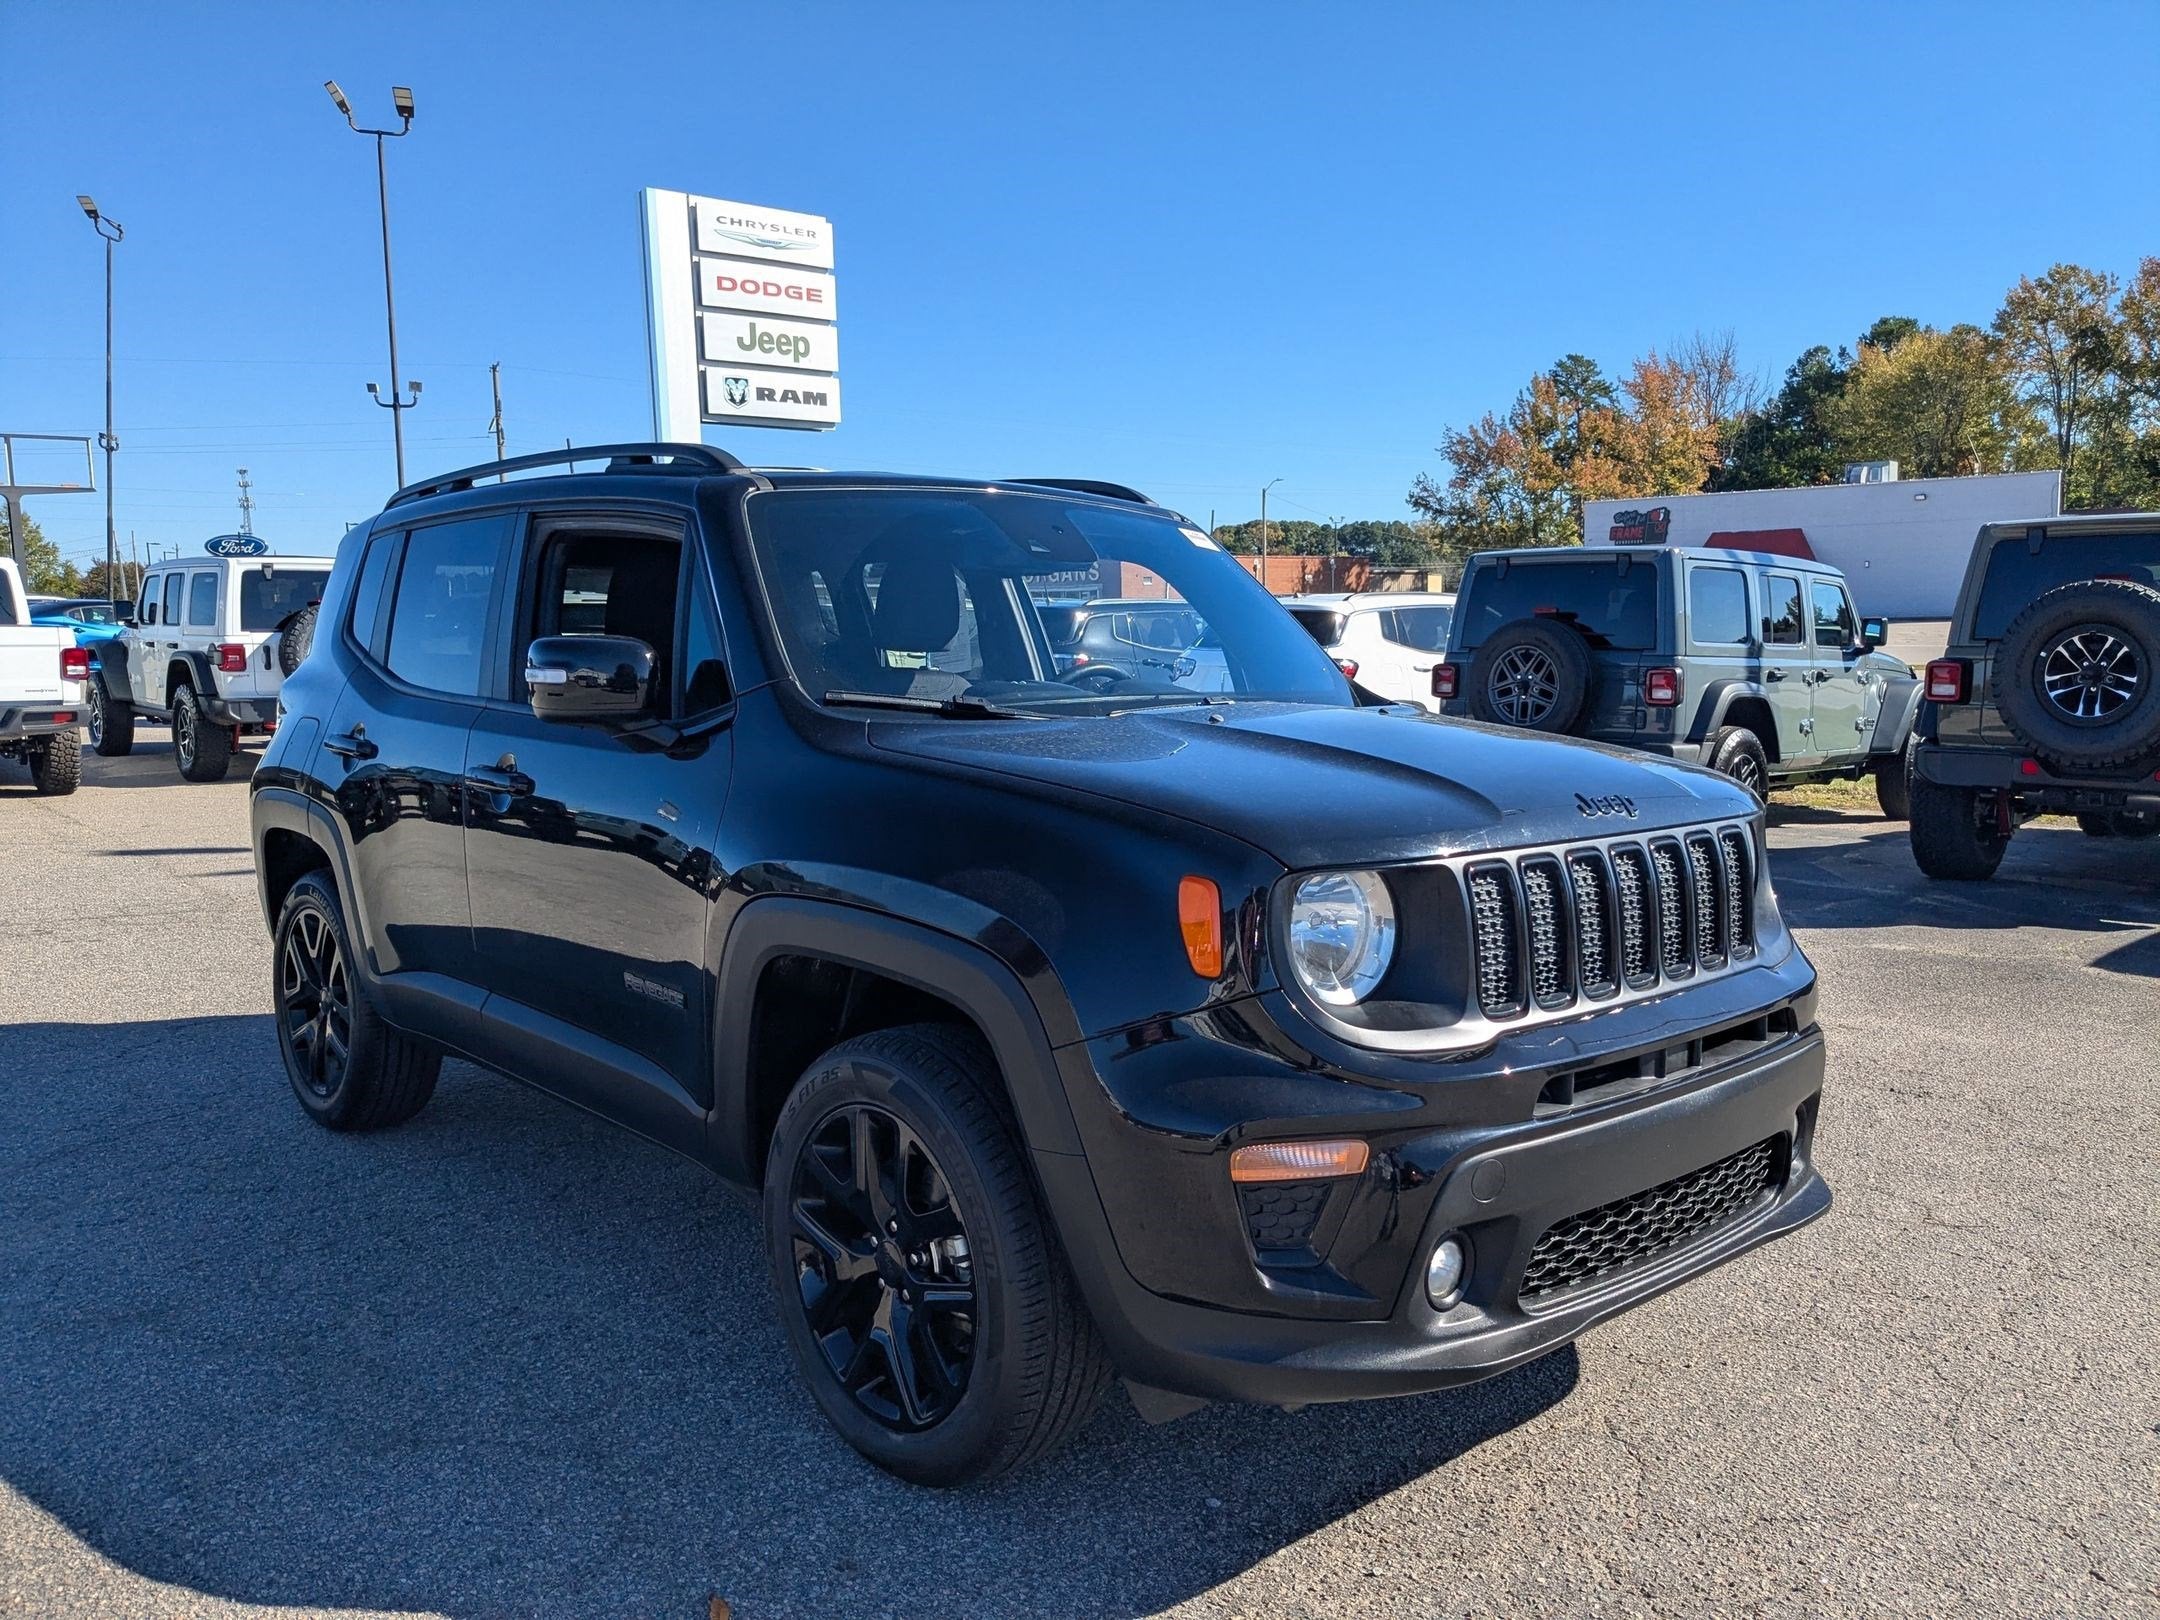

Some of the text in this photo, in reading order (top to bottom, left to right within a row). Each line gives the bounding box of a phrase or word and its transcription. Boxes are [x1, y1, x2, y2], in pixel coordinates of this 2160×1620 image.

[716, 215, 817, 239] CHRYSLER
[716, 275, 823, 303] DODGE
[736, 322, 811, 363] Jeep
[755, 386, 828, 406] RAM
[1612, 526, 1645, 540] FRAME
[218, 539, 255, 553] Ford
[1574, 792, 1638, 818] Jeep
